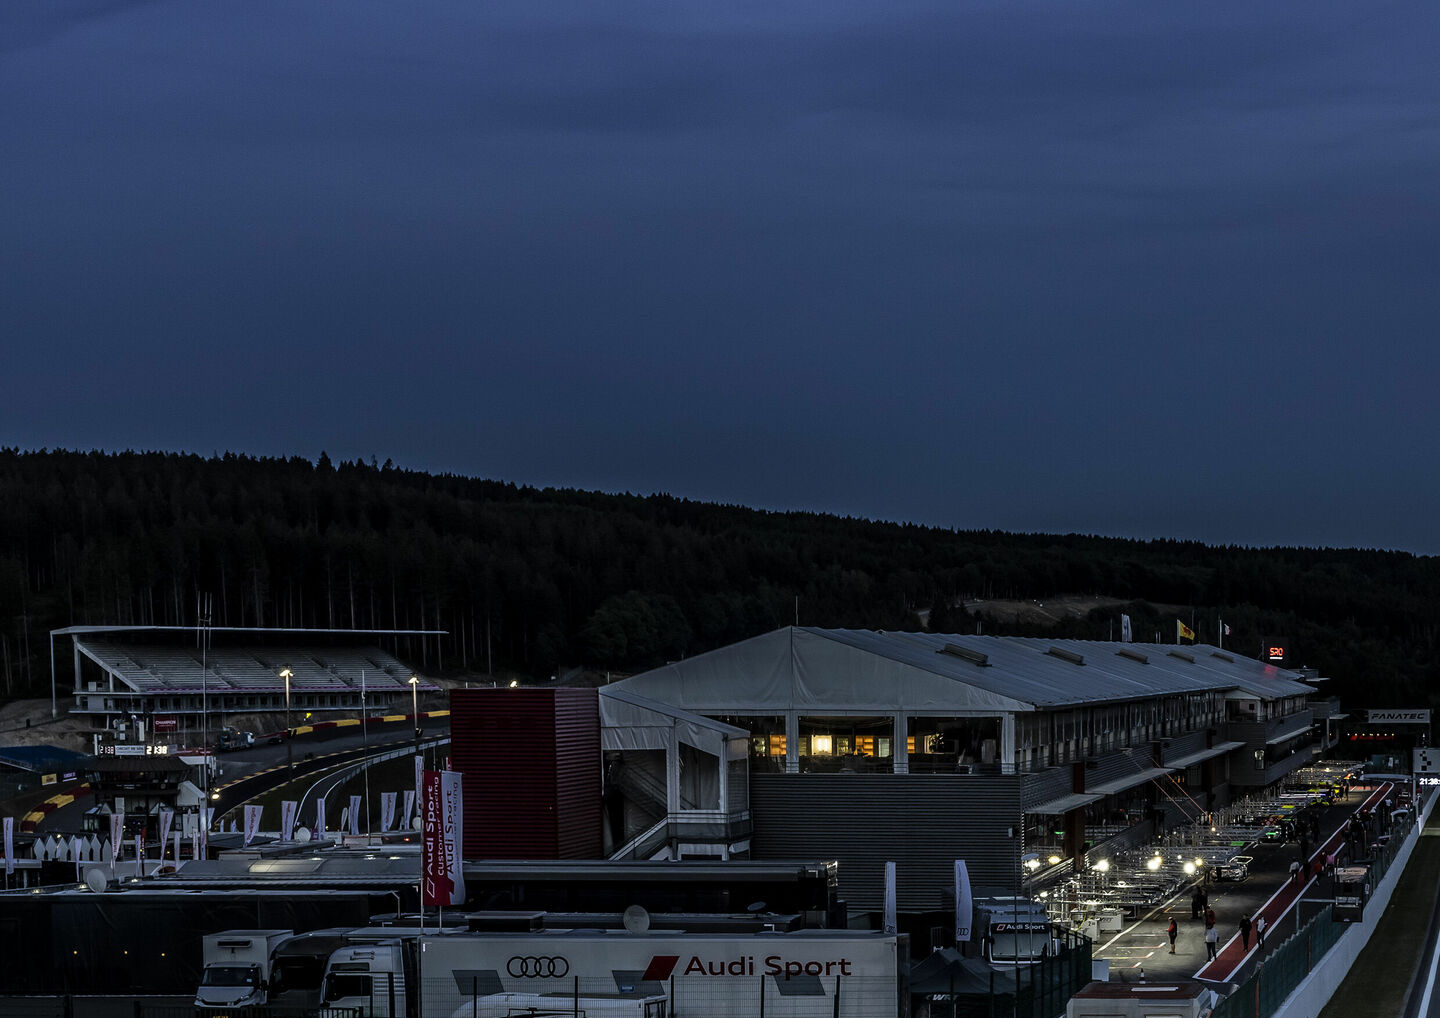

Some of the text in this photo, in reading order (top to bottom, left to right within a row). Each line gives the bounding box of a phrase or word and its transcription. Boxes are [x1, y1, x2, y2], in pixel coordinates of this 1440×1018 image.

[1270, 647, 1283, 656] SRO
[1371, 712, 1425, 720] FANATEC
[147, 746, 168, 755] 21:38
[426, 786, 437, 876] Audi Sport
[446, 791, 454, 874] Audi Sport
[436, 820, 444, 875] customer
[1006, 923, 1045, 932] Audi Sport
[684, 956, 851, 981] Audi Sport
